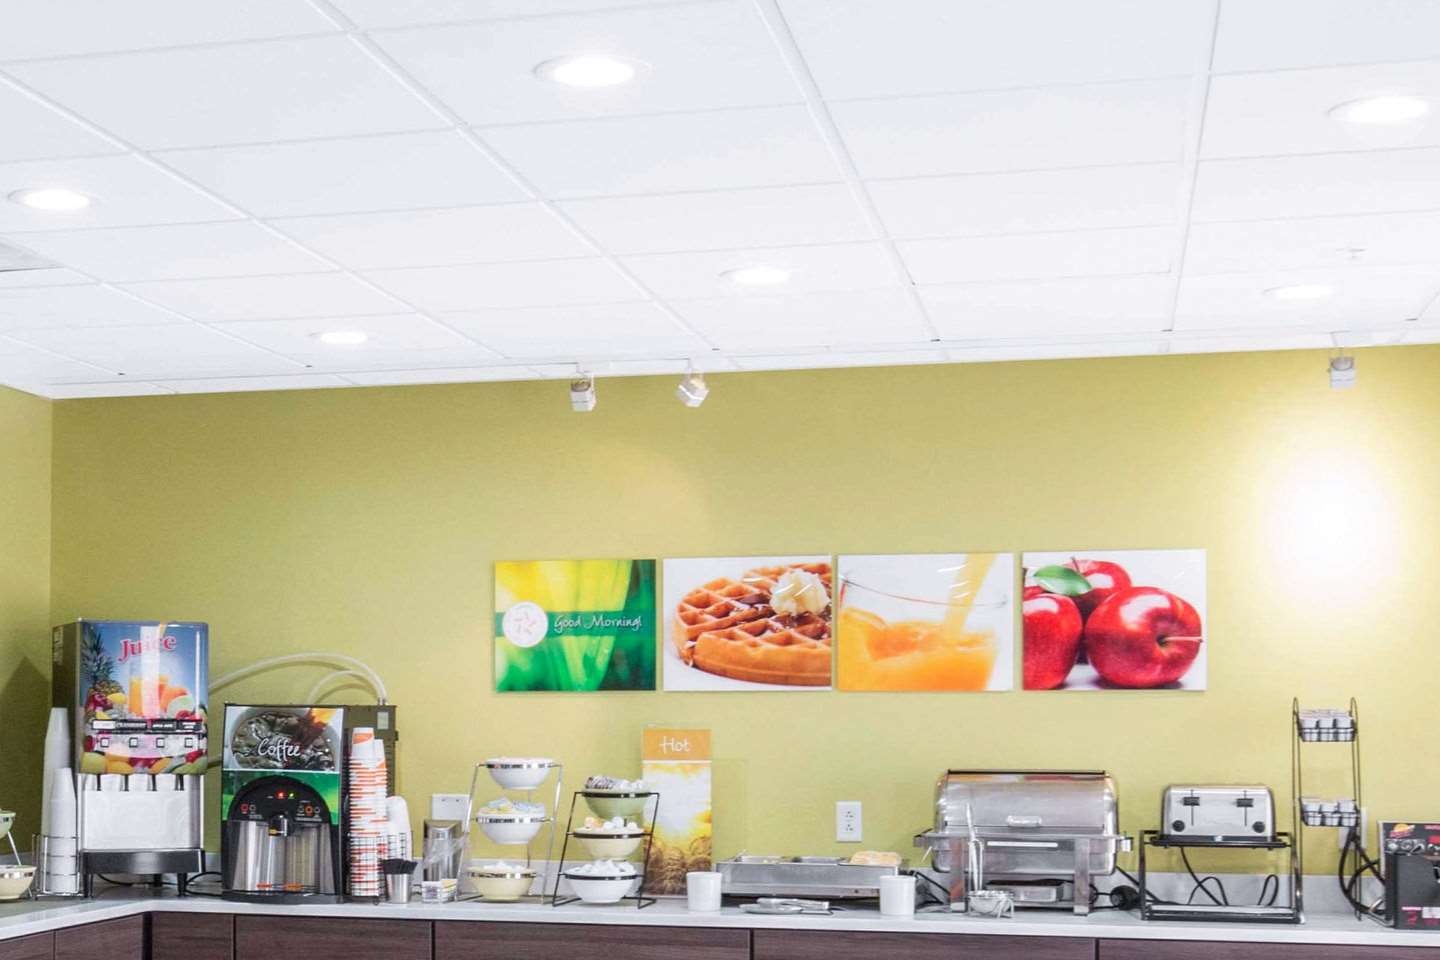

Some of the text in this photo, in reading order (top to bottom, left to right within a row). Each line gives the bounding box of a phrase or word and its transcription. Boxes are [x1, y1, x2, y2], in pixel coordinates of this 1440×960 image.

[554, 614, 642, 633] Good Morning!
[117, 635, 177, 663] Juice
[257, 737, 301, 761] Coffee
[658, 735, 689, 755] Hot
